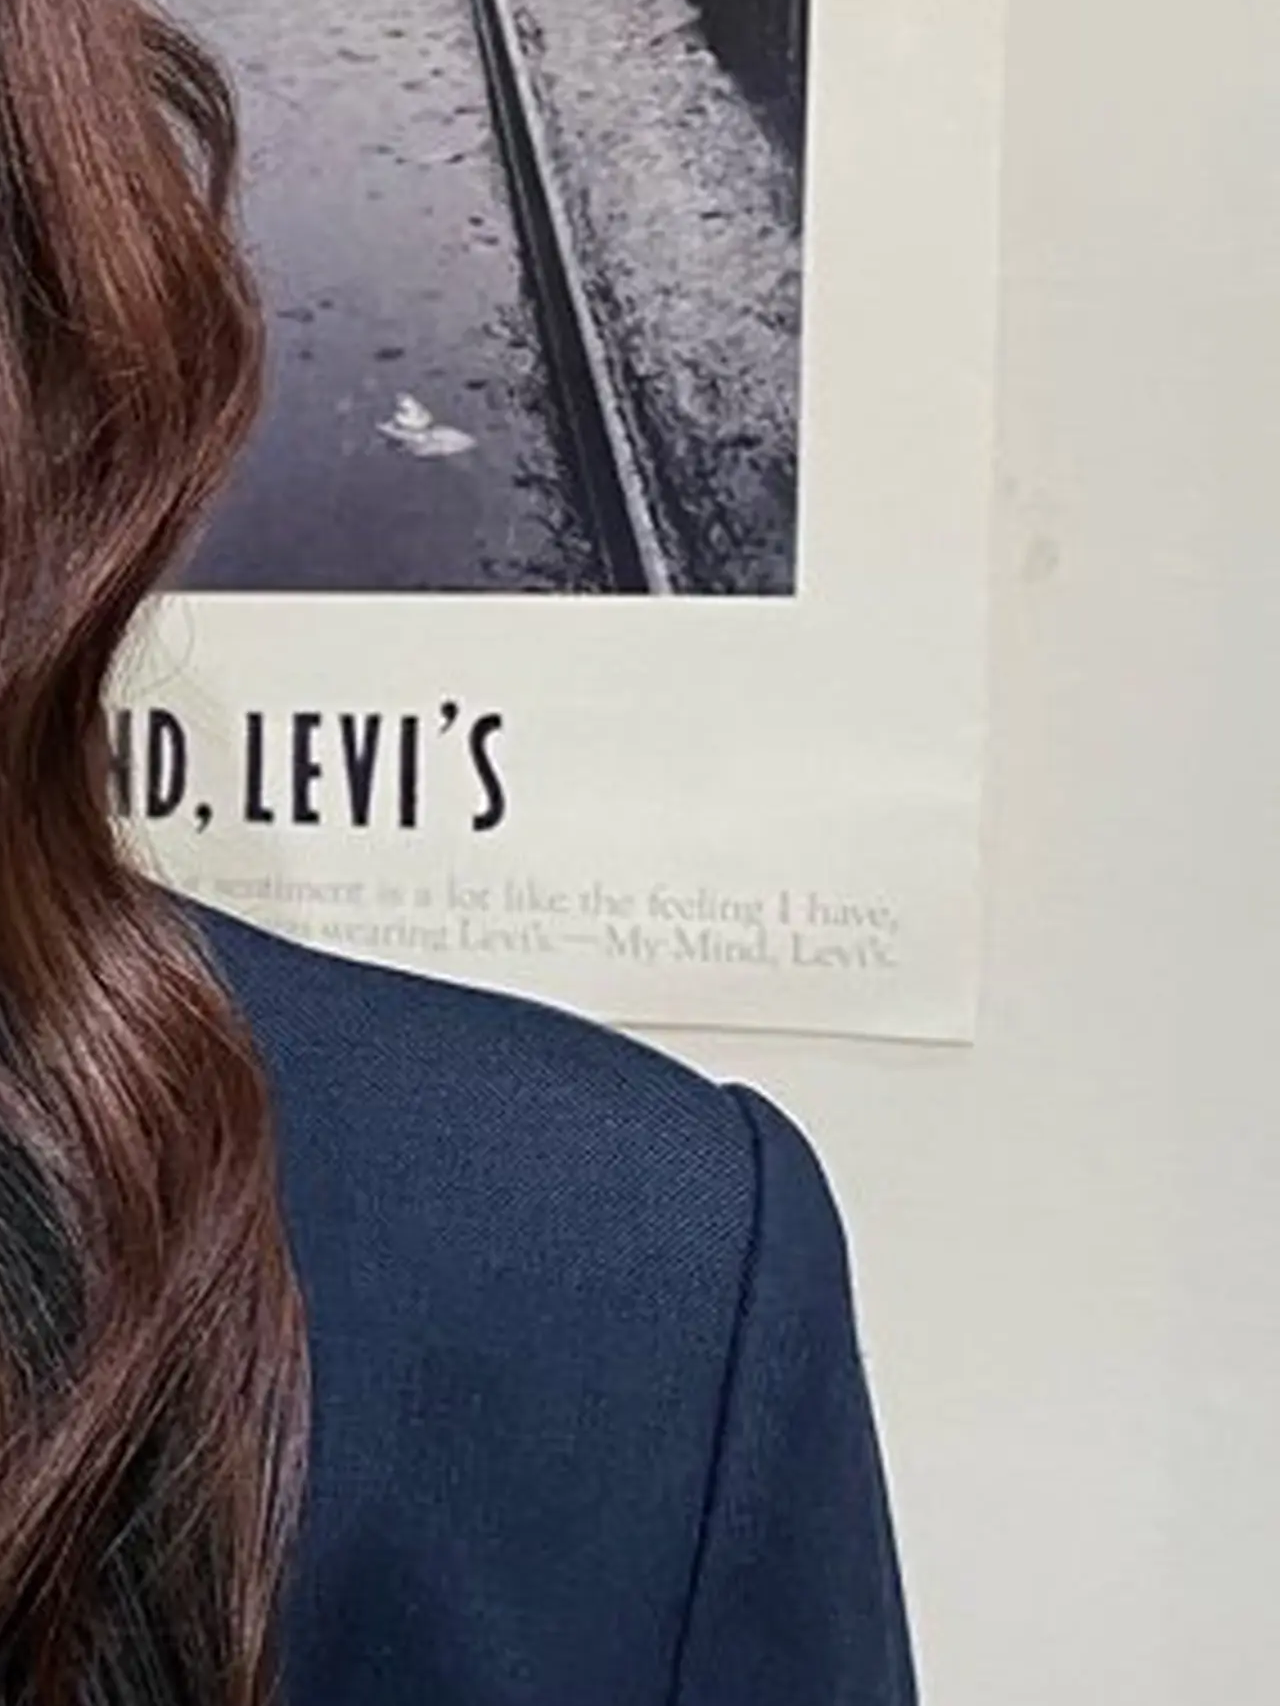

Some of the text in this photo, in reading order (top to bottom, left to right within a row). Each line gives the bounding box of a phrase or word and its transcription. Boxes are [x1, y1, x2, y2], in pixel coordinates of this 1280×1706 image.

[242, 700, 507, 832] LEVI'S
[504, 876, 571, 914] like
[578, 879, 636, 919] the
[648, 882, 765, 930] feeling
[807, 890, 900, 937] have,
